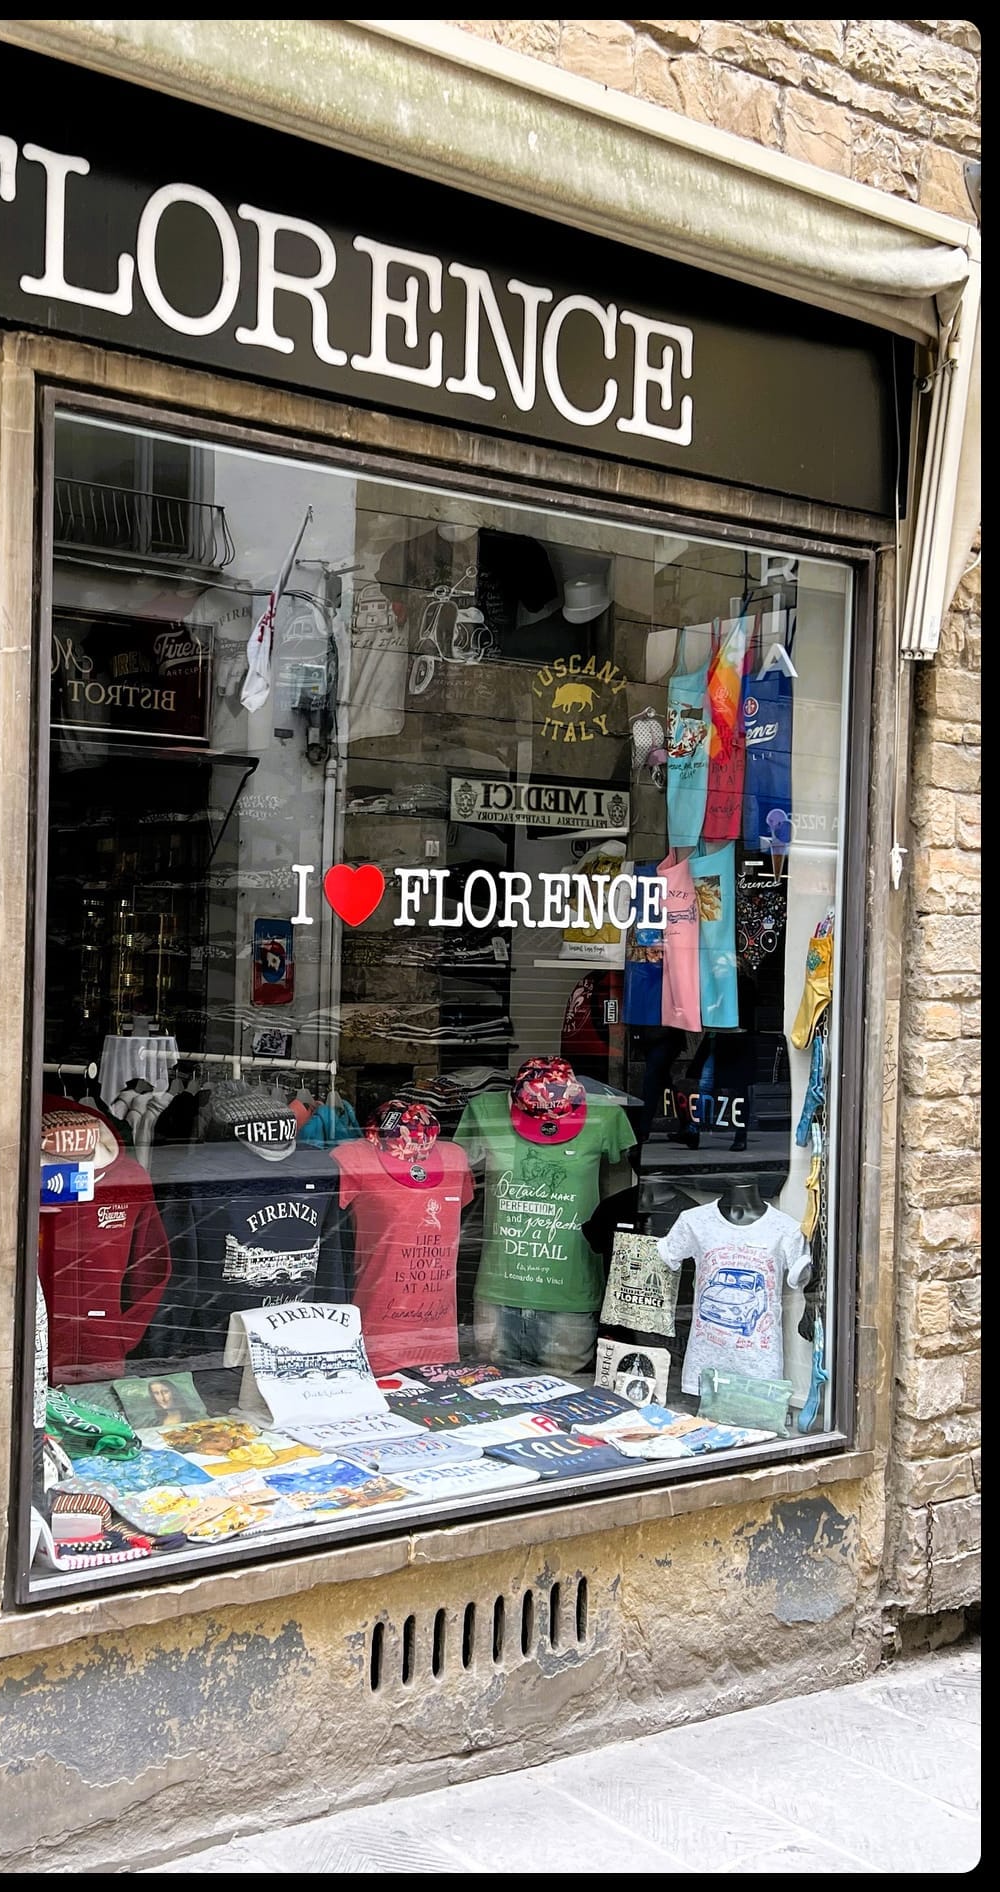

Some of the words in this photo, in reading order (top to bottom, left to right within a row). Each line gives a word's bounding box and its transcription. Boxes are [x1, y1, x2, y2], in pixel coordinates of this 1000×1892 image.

[541, 714, 609, 742] ITALY
[290, 864, 315, 926] I
[393, 867, 668, 930] FLORENCE
[246, 1202, 318, 1233] FIRENZE
[500, 1200, 556, 1216] PERFECTION
[504, 1239, 568, 1261] DETAIL
[614, 1291, 664, 1309] FLORENCE
[265, 1306, 351, 1330] FIRENZE
